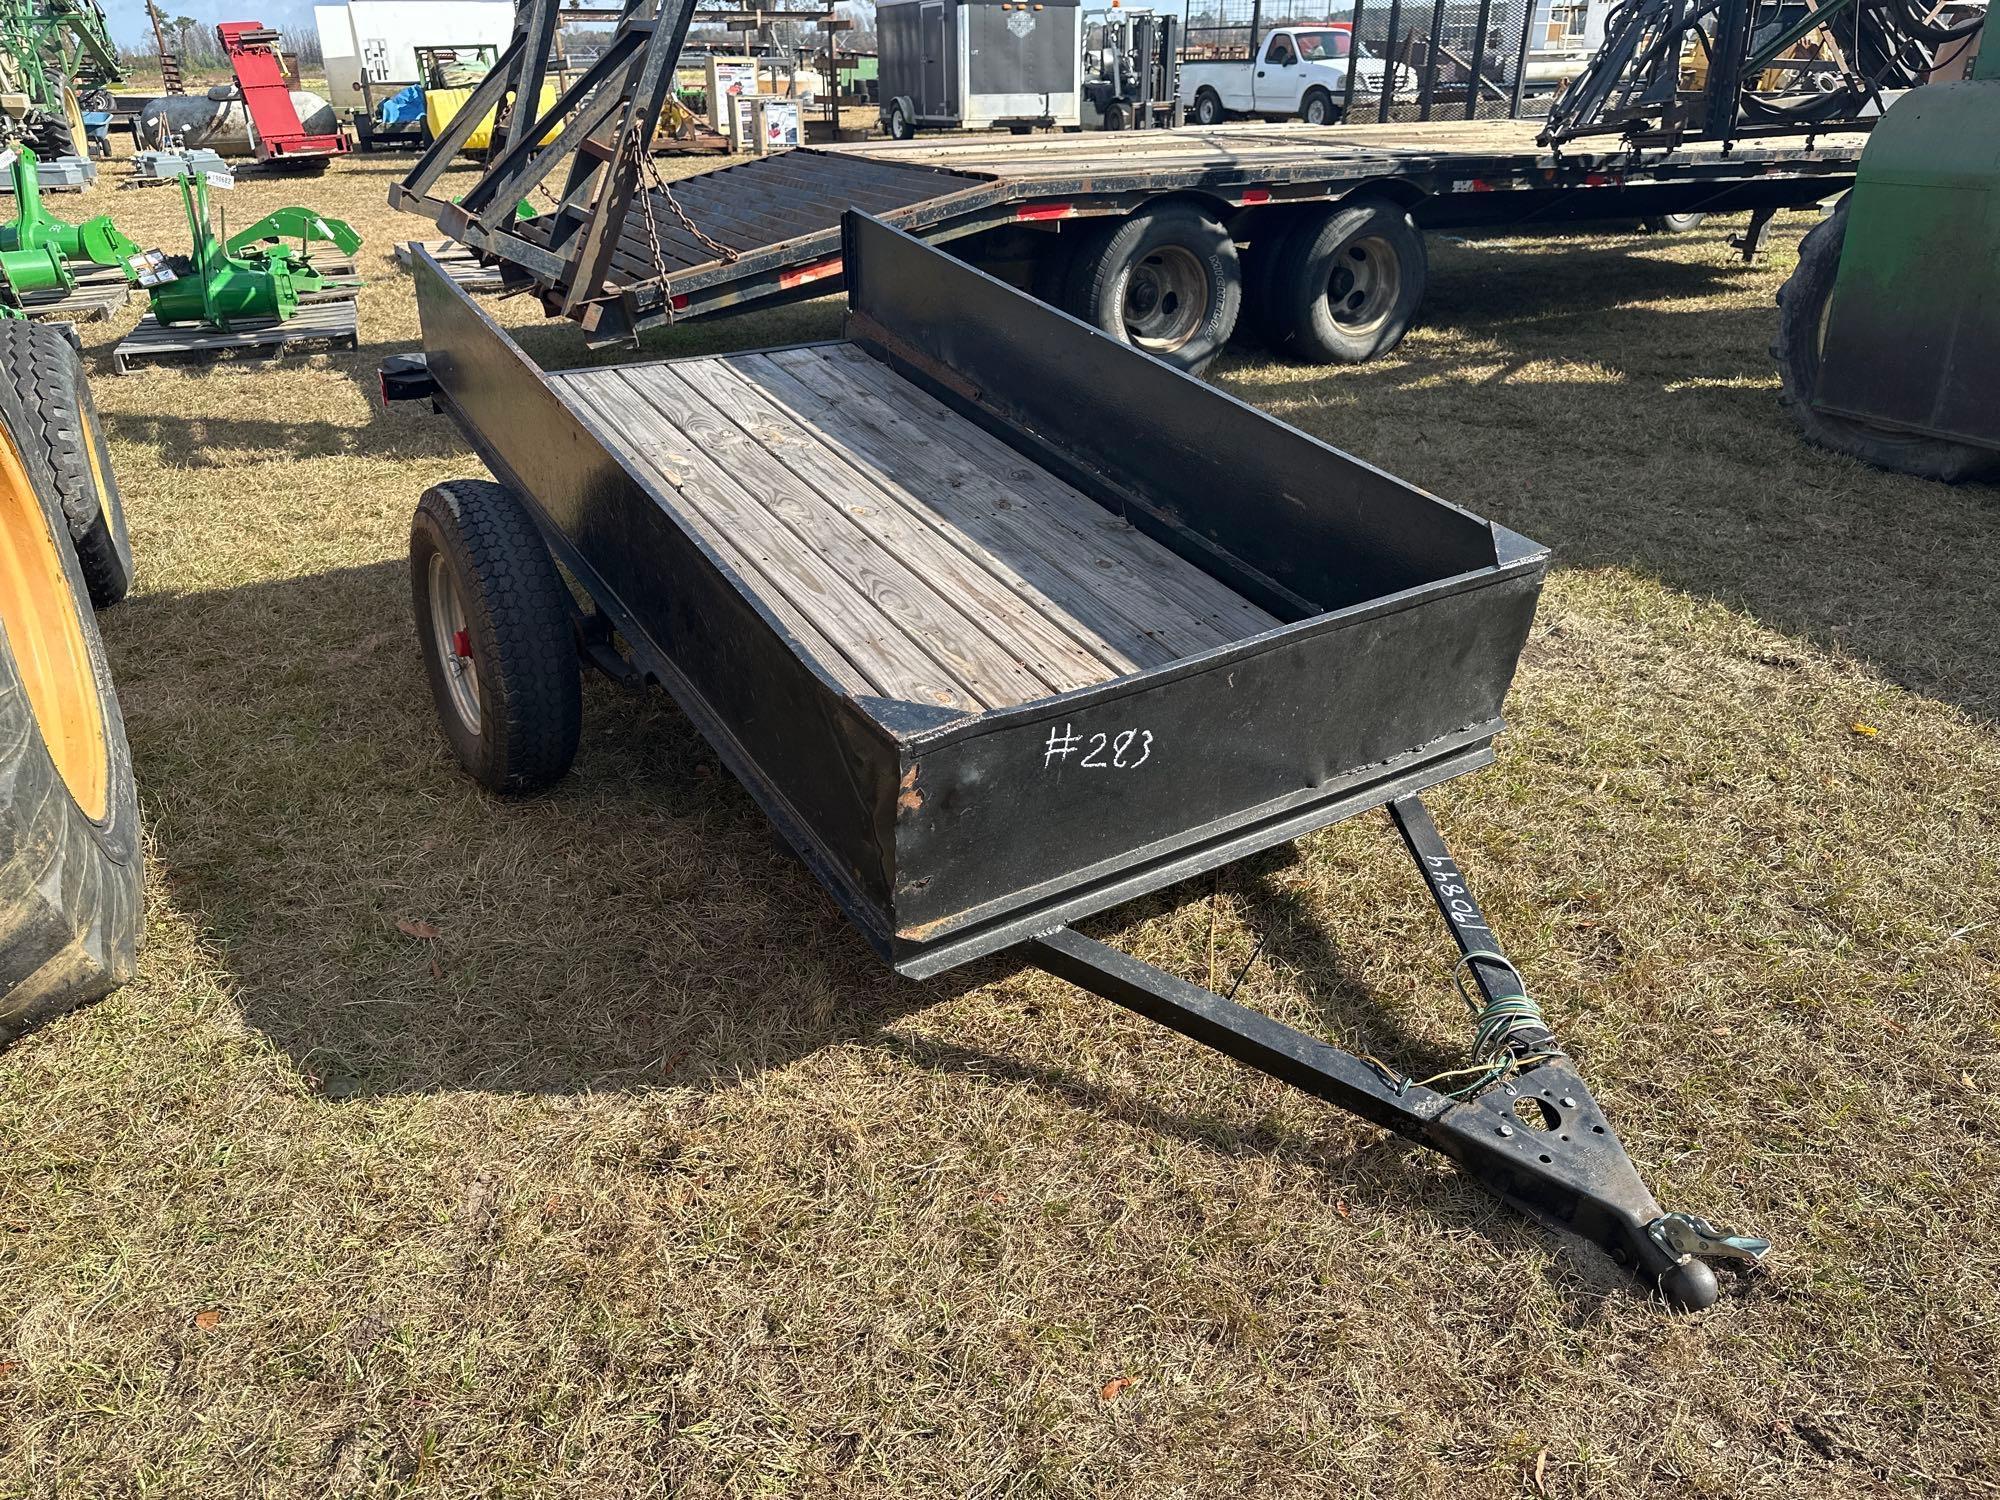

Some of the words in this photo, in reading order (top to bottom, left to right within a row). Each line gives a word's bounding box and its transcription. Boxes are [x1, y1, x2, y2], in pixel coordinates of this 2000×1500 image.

[1204, 254, 1226, 341] MICHELIN
[1044, 722, 1154, 769] #283
[1426, 855, 1491, 930] 190844
